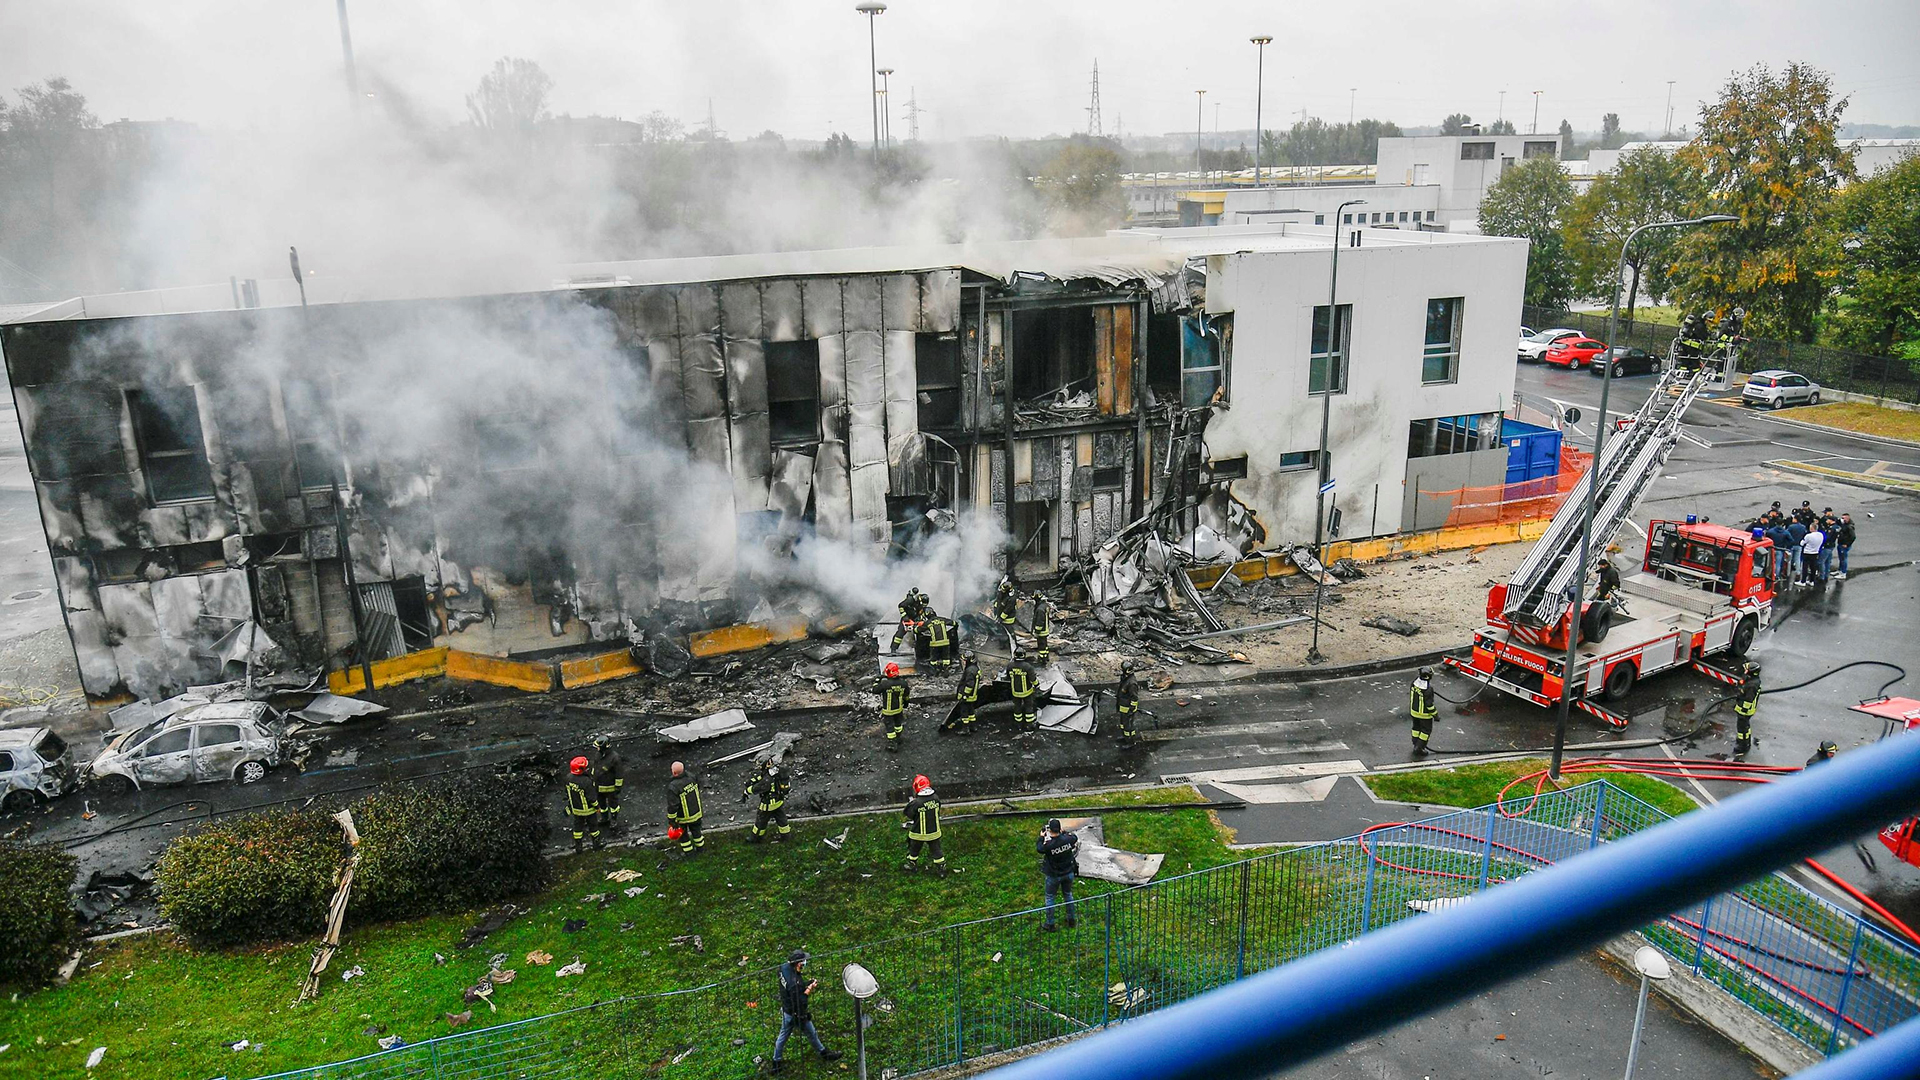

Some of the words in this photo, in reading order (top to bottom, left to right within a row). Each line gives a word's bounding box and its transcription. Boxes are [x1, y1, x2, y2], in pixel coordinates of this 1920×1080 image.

[1513, 656, 1524, 664] DEL
[1524, 660, 1544, 672] FUOCO
[1050, 843, 1072, 855] POLIZIA
